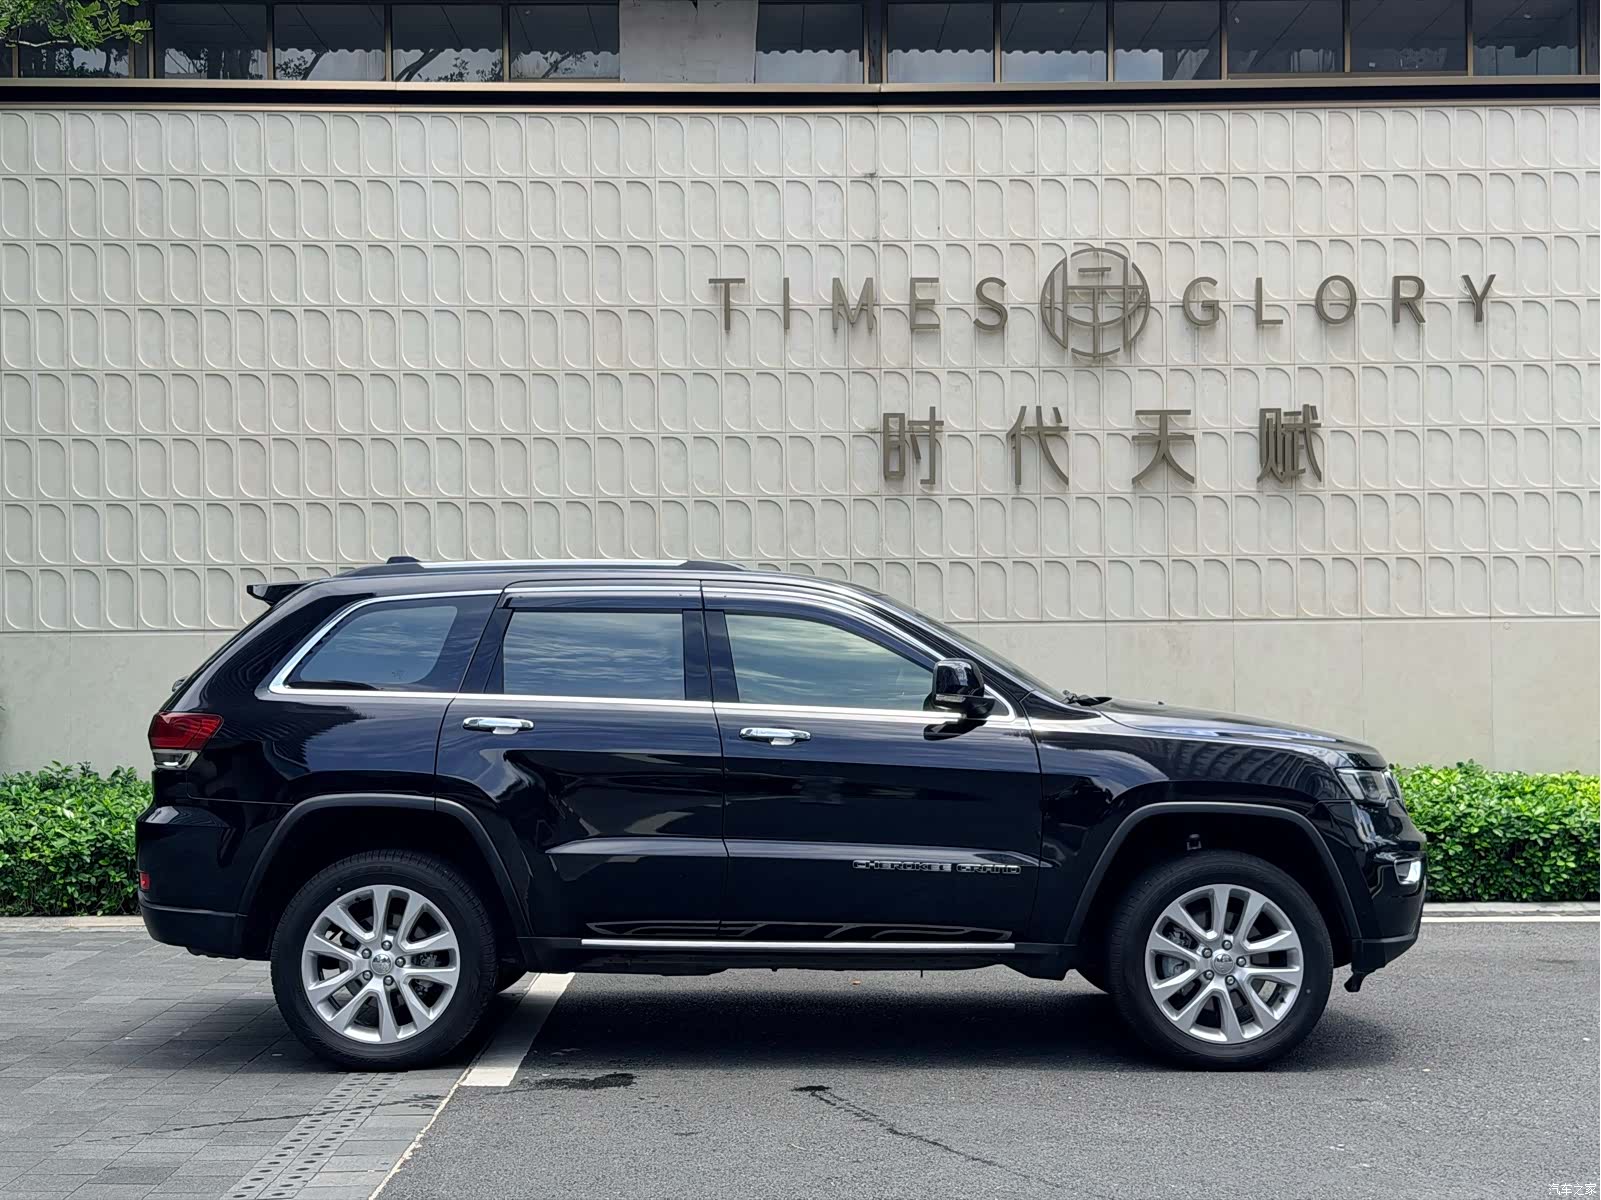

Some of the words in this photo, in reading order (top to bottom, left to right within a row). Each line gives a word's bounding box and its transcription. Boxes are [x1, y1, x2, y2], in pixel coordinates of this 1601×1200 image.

[708, 276, 1009, 331] TIMES
[1182, 274, 1497, 327] GLORY
[882, 404, 1323, 485] 时代天赋
[852, 860, 952, 872] CHEROKEE
[956, 864, 1021, 874] GRAND
